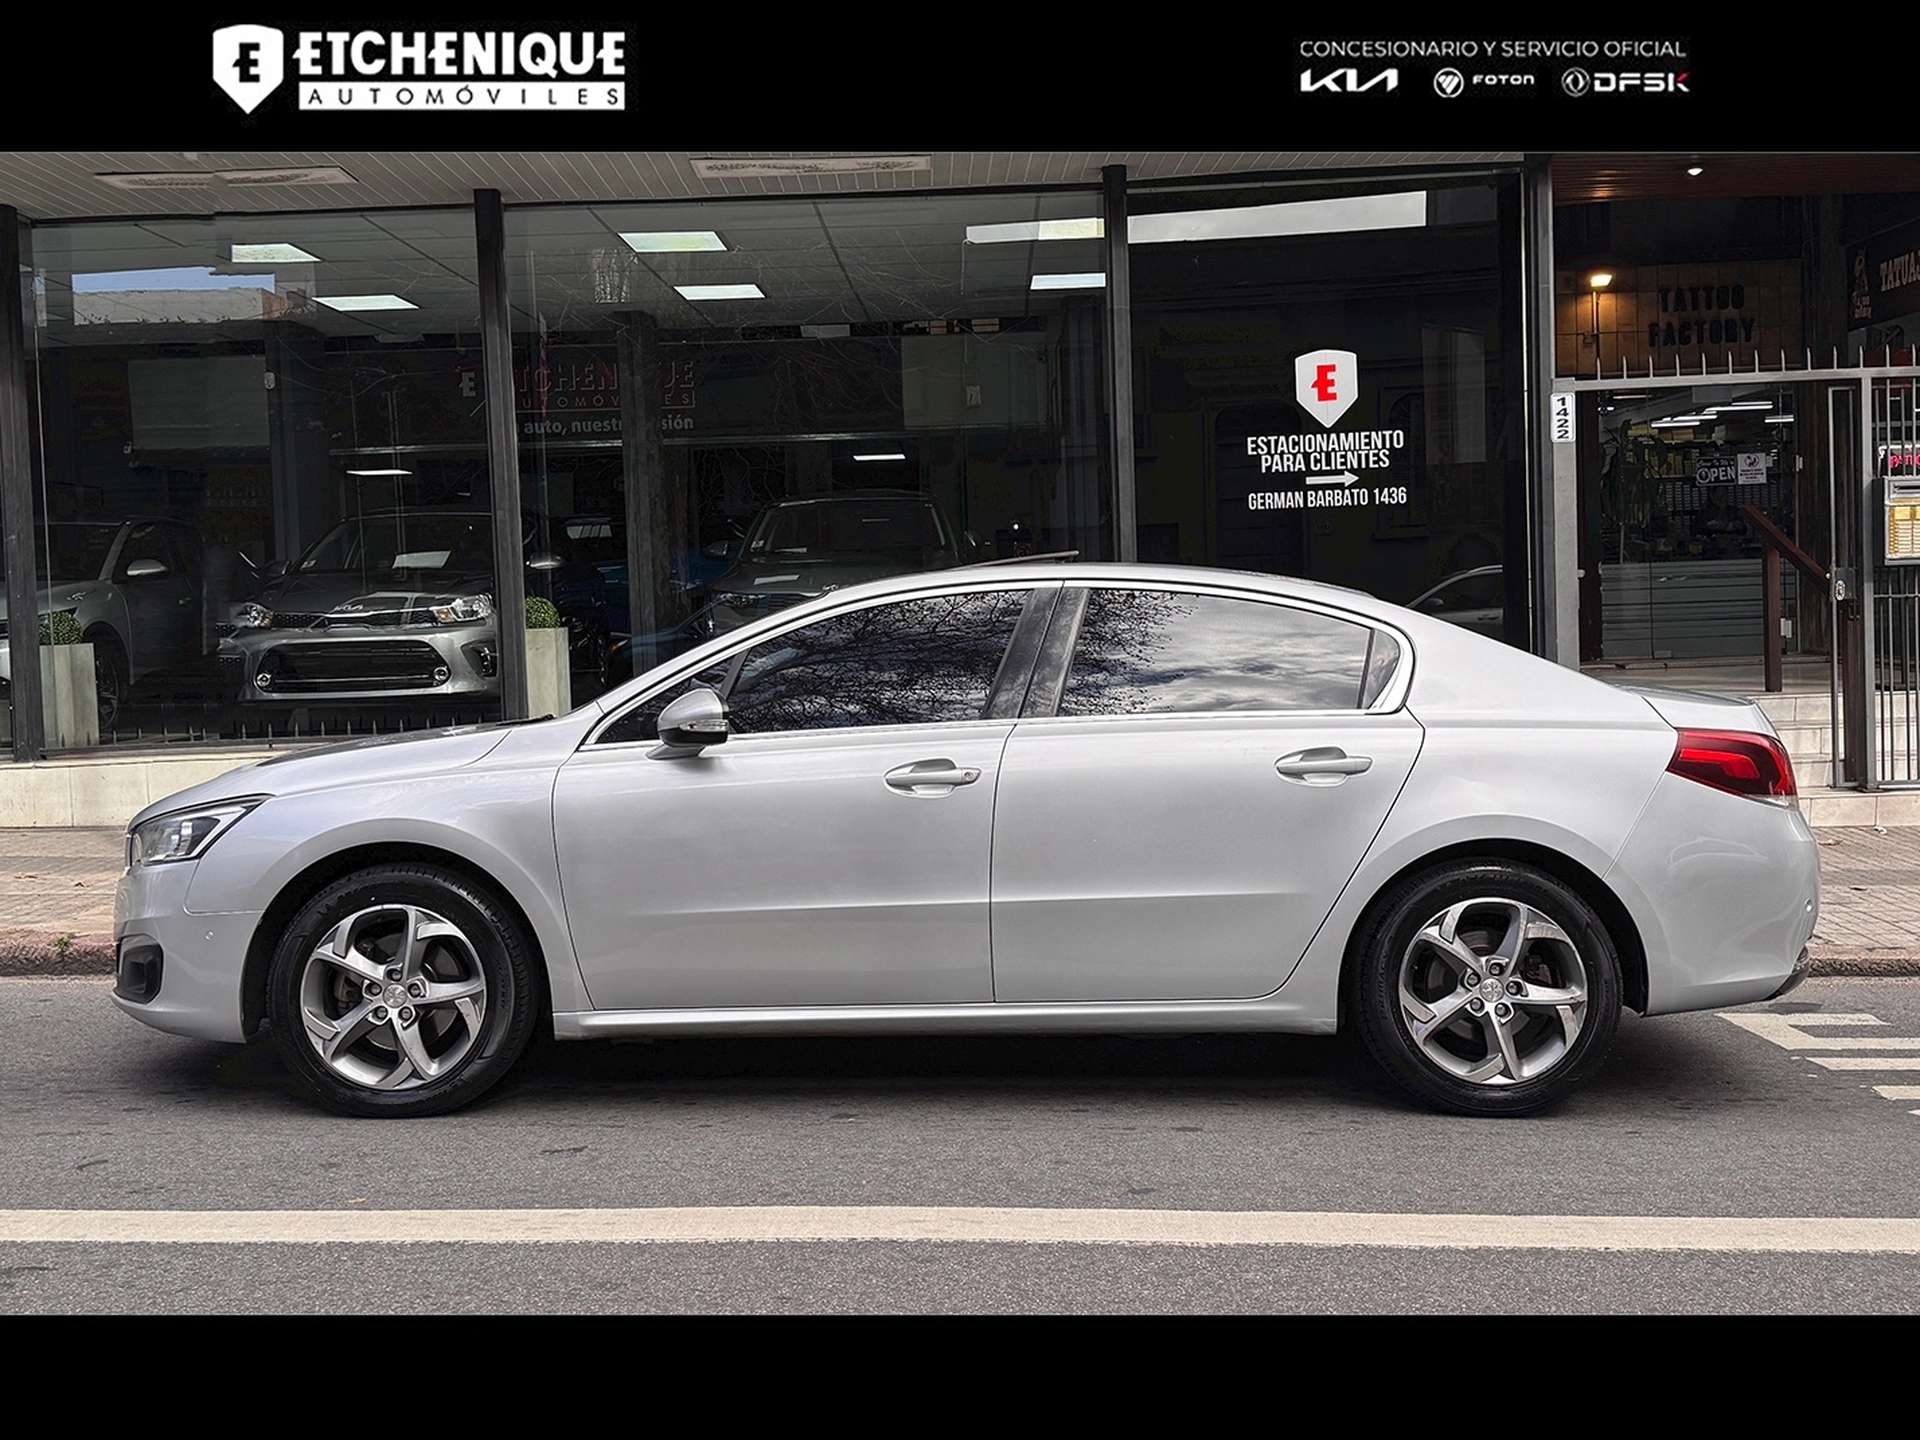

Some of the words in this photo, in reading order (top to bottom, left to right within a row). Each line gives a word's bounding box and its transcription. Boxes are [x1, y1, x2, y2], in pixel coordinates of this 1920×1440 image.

[1879, 249, 1920, 293] TATUA
[1659, 284, 1744, 312] TATTOO
[1648, 318, 1755, 347] FACTORY
[1556, 396, 1570, 440] 1422
[1247, 430, 1404, 455] ESTACIONAMIENTO
[1261, 453, 1306, 473] PARA
[1310, 449, 1390, 471] CLIENTES
[1696, 466, 1736, 484] OPEN
[1248, 490, 1304, 510] GERMAN
[1307, 488, 1368, 508] BARBATO
[1373, 486, 1407, 505] 1436
